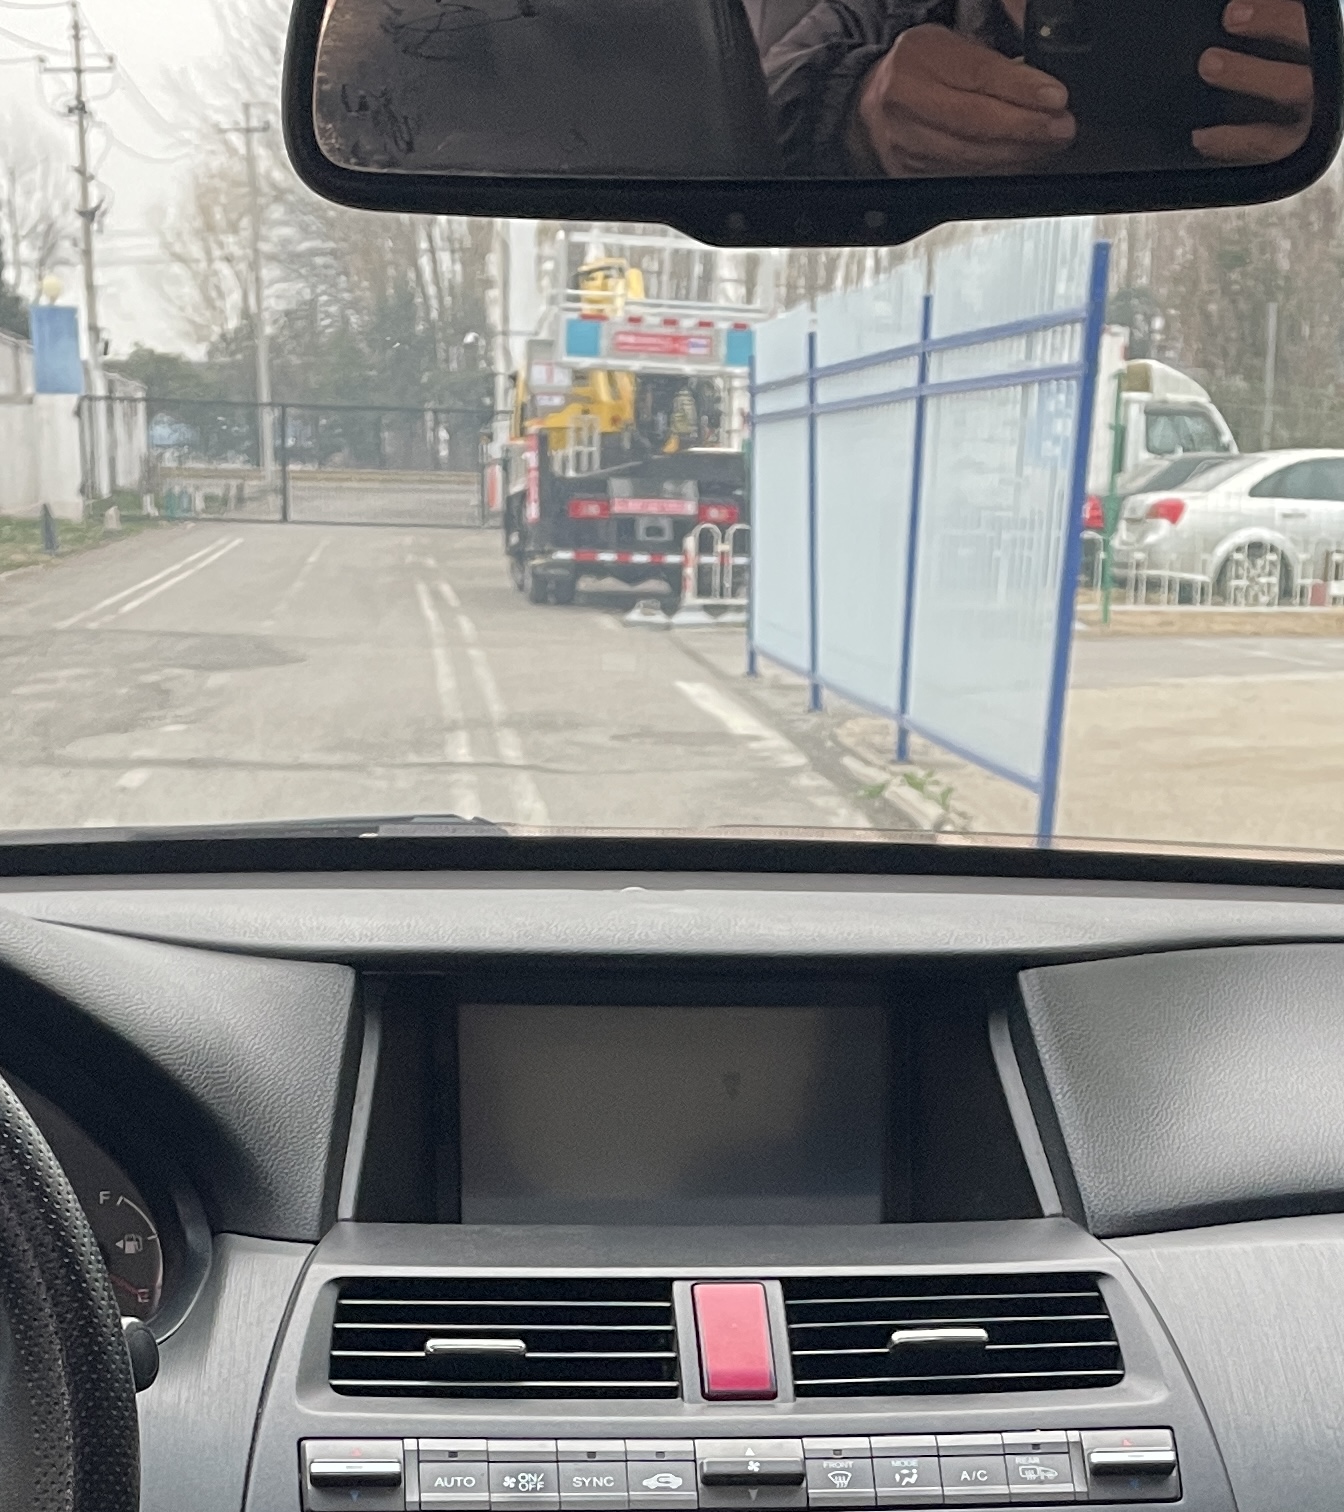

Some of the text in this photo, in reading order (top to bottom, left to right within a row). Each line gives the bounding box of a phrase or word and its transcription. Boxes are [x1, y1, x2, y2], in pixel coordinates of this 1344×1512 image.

[99, 1190, 111, 1205] F
[823, 1460, 854, 1469] FRONT
[891, 1459, 919, 1467] MODE
[1015, 1457, 1041, 1465] REAR
[434, 1475, 476, 1488] AUTO
[517, 1473, 544, 1485] ON/
[572, 1475, 615, 1488] SYNC
[960, 1469, 988, 1482] A/C
[518, 1479, 545, 1492] OFF
